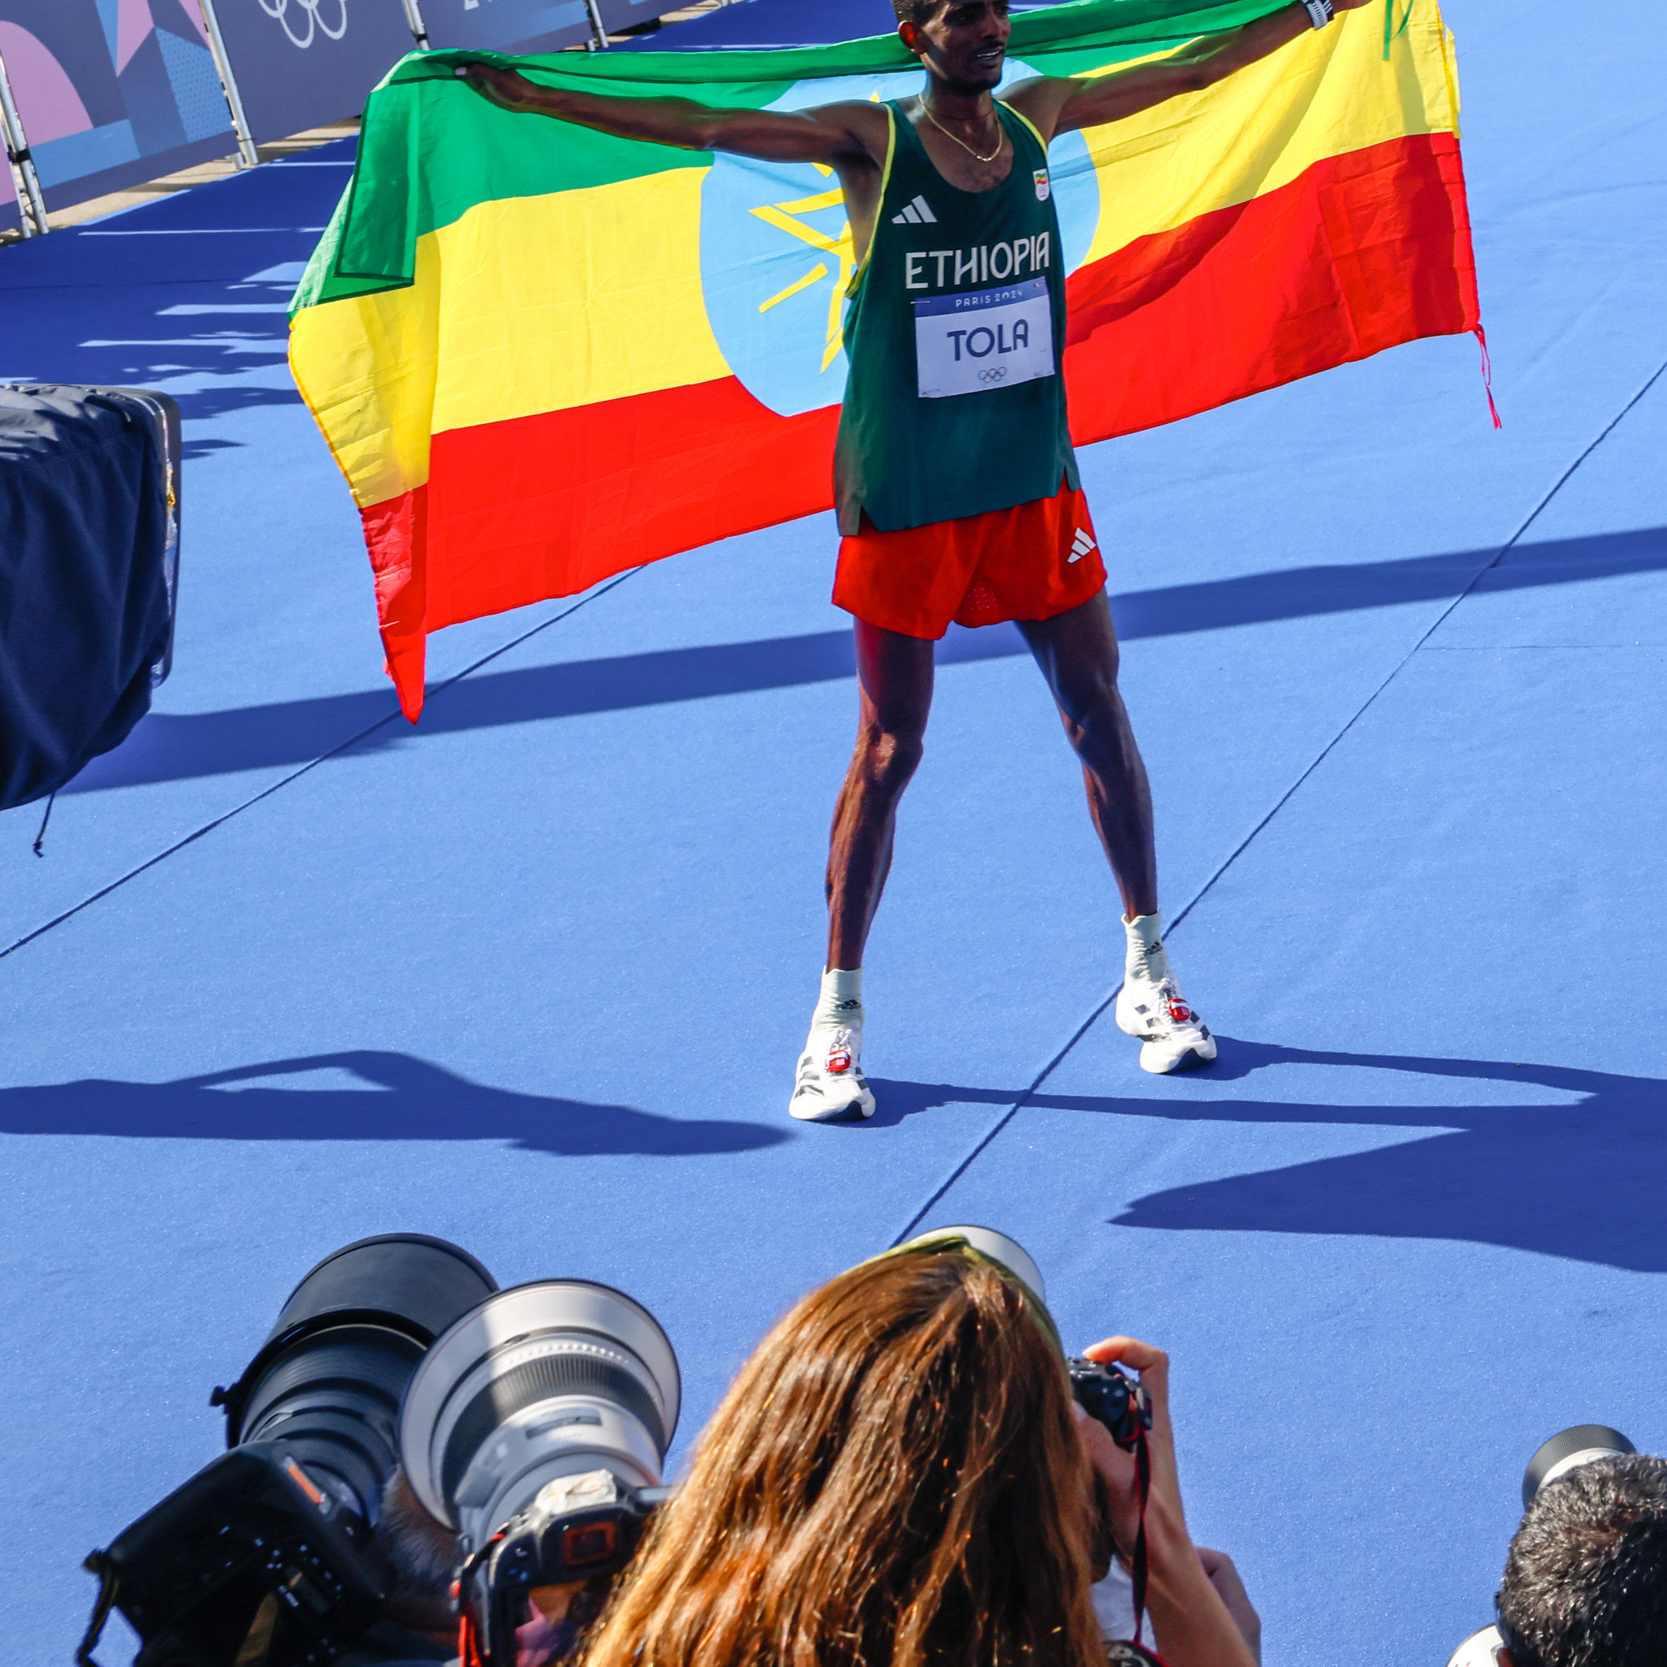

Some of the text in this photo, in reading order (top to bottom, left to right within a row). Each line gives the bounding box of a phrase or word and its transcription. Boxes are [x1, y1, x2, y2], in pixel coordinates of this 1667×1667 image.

[905, 231, 1050, 289] ETHIOPIA
[955, 289, 1023, 308] PARIS 2024
[947, 318, 1028, 361] TOLA
